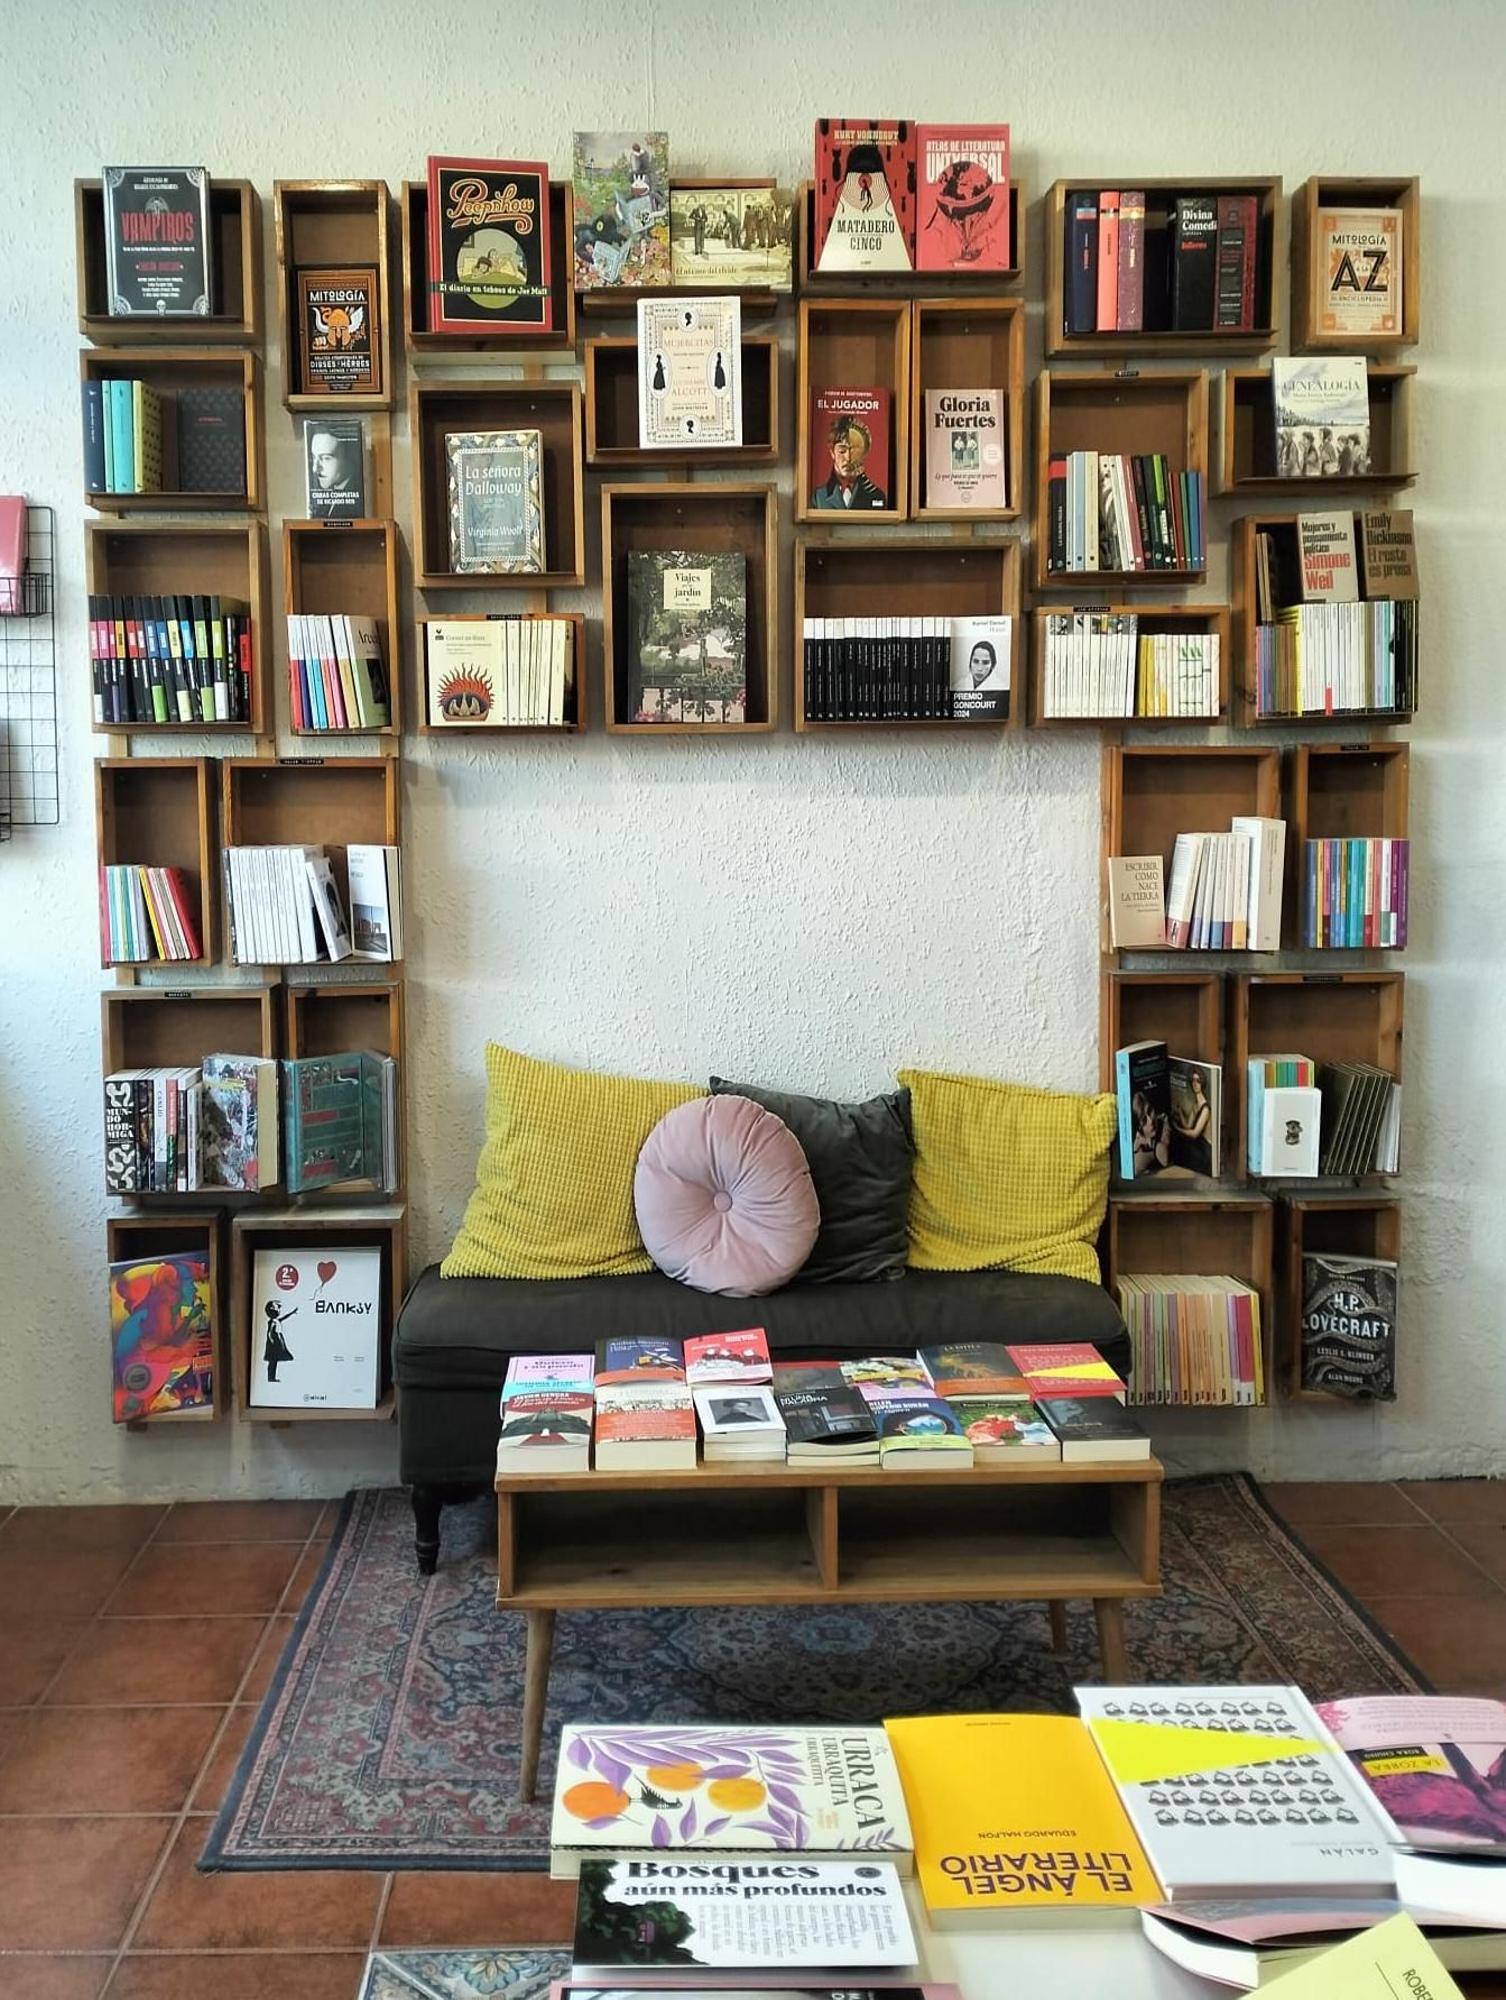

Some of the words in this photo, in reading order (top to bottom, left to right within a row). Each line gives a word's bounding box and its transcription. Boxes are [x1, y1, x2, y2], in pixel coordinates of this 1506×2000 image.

[1182, 209, 1213, 220] Divina
[121, 211, 194, 243] VAMPIROS
[837, 220, 895, 234] MATADERO
[1182, 220, 1217, 231] Comedi
[850, 236, 882, 251] CINCO
[1332, 234, 1387, 246] MITOLOGÍA
[1331, 251, 1361, 292] A
[1363, 251, 1388, 292] Z
[309, 290, 366, 302] MITOLOGÍA
[818, 399, 829, 409] EL
[831, 399, 879, 410] JUGADOR
[939, 396, 991, 412] Gloria
[934, 413, 996, 428] Fuertes
[465, 466, 480, 479] La
[482, 464, 521, 479] señora
[465, 481, 522, 497] Dalloway
[1304, 554, 1351, 570] Simone
[675, 573, 701, 584] Viajes
[1305, 570, 1334, 590] Weil
[674, 587, 701, 598] jardín
[954, 692, 982, 701] PREMIO
[954, 701, 996, 709] GONCOURT
[1135, 872, 1159, 881] COMO
[315, 1300, 372, 1315] BANKSY
[1302, 1313, 1391, 1338] LOVECRAFT
[821, 1737, 849, 1806] URRAQUITA
[841, 1737, 886, 1830] URRACA
[977, 1830, 1022, 1839] HALFON
[1022, 1830, 1077, 1838] EDUARDO
[940, 1852, 1133, 1875] LITERARIO
[627, 1861, 820, 1882] Bosques
[623, 1880, 679, 1896] aún
[682, 1881, 739, 1896] más
[743, 1881, 888, 1898] profundos
[952, 1872, 1077, 1897] ÁNGEL
[1086, 1872, 1134, 1892] EL
